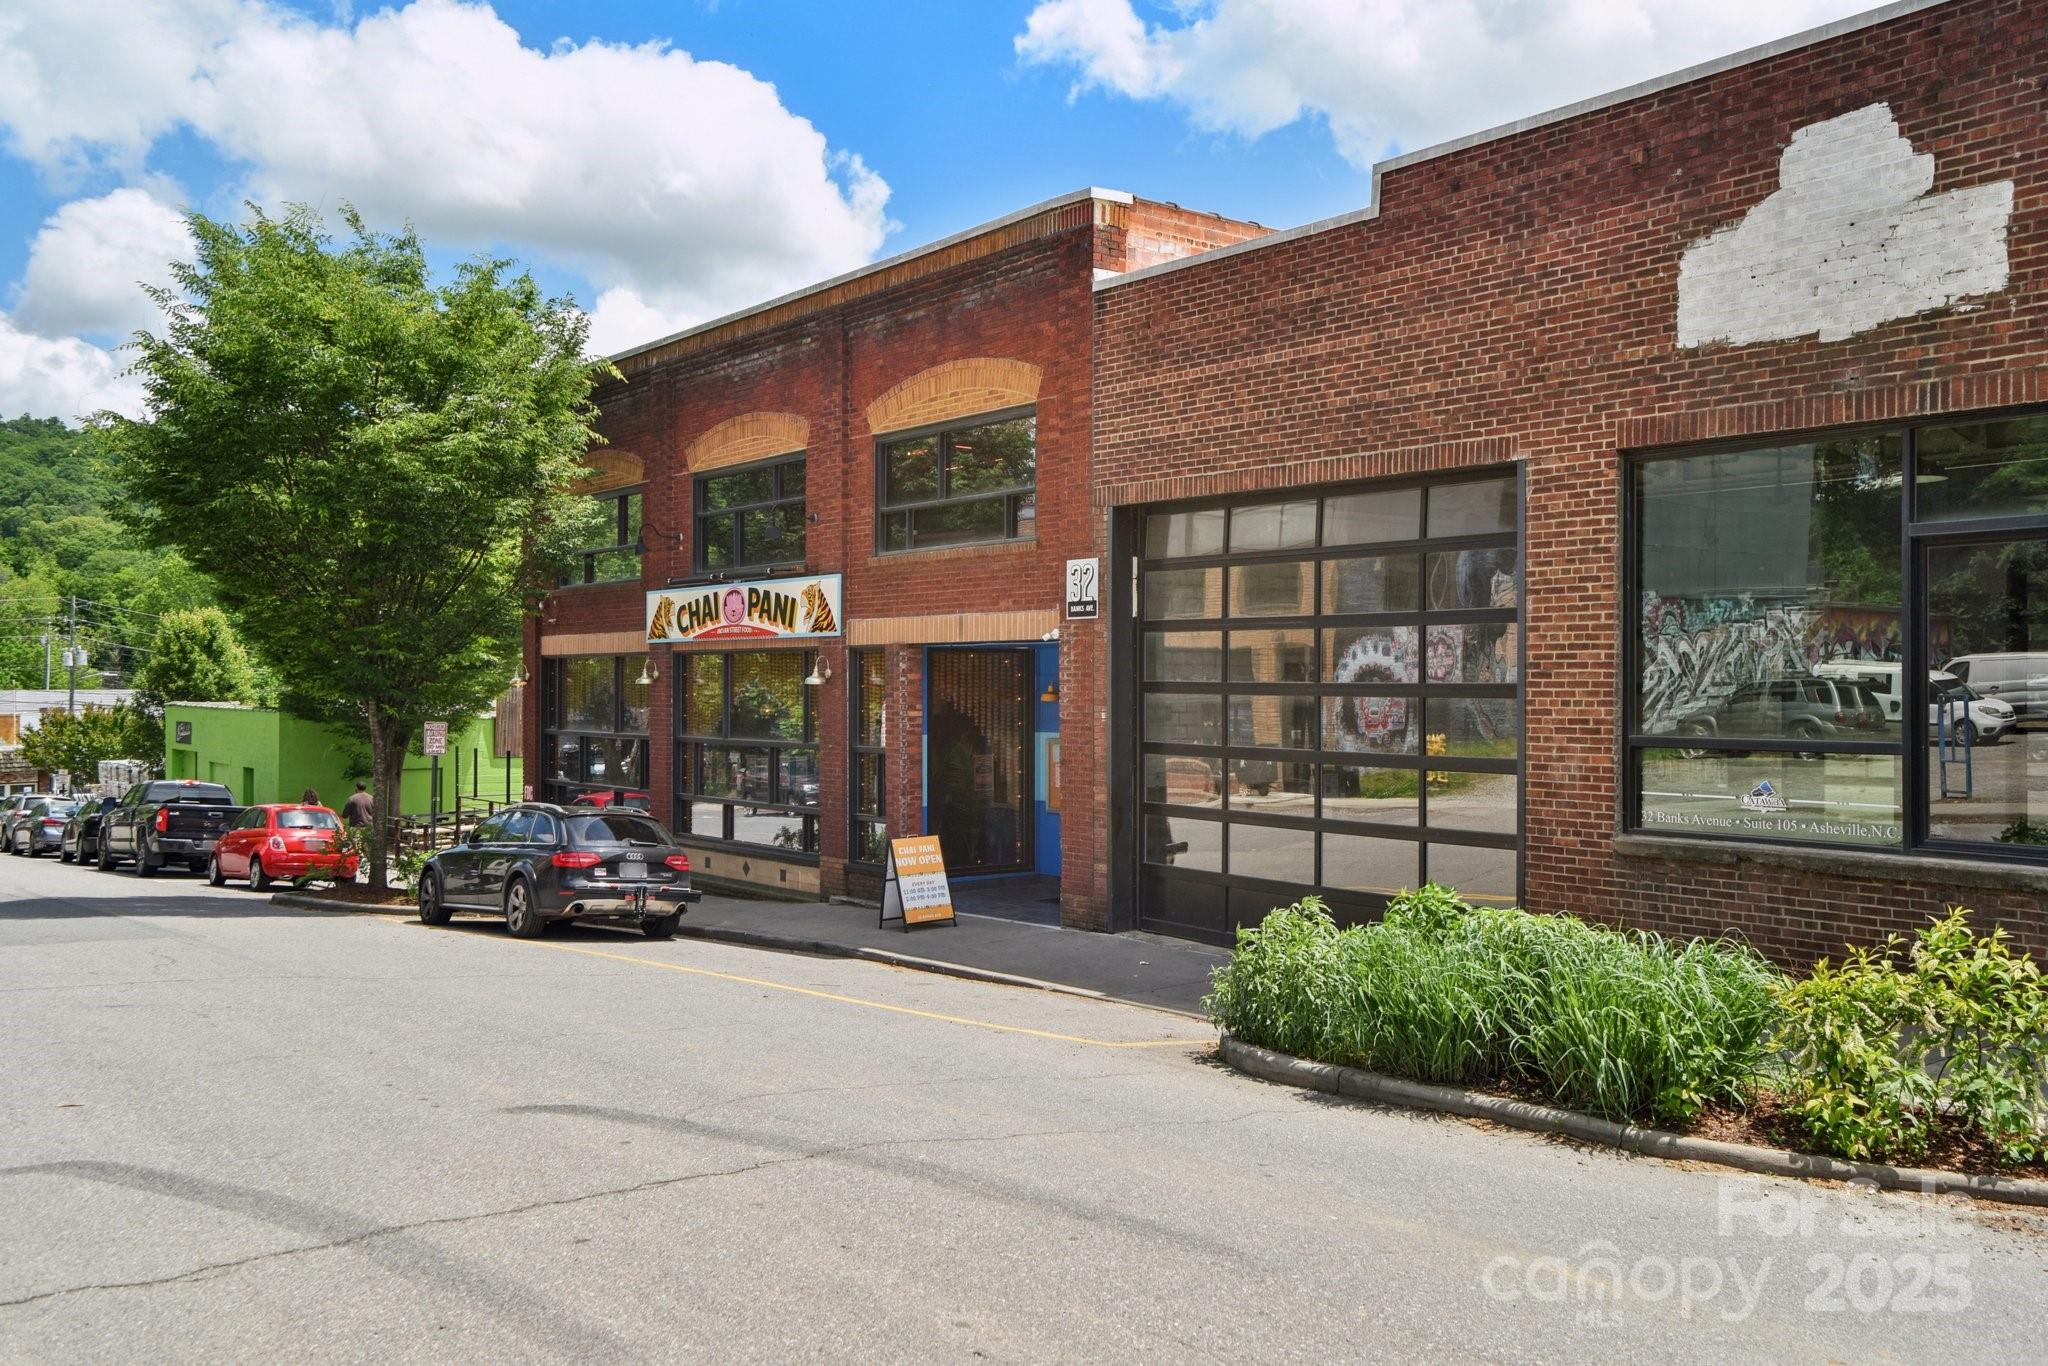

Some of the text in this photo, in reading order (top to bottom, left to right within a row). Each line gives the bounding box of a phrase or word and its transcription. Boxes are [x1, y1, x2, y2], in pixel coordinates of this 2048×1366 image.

[1071, 564, 1094, 601] 32
[677, 587, 799, 636] CHAI PANI
[1741, 794, 1787, 807] CATAWBA
[1641, 810, 1654, 823] 32
[1657, 812, 1689, 825] Banks
[1691, 814, 1732, 827] Avenue
[1743, 817, 1773, 831] Suite
[1777, 819, 1797, 832] 105
[898, 844, 935, 855] CHAI PANI
[896, 854, 943, 866] NOW OPEN
